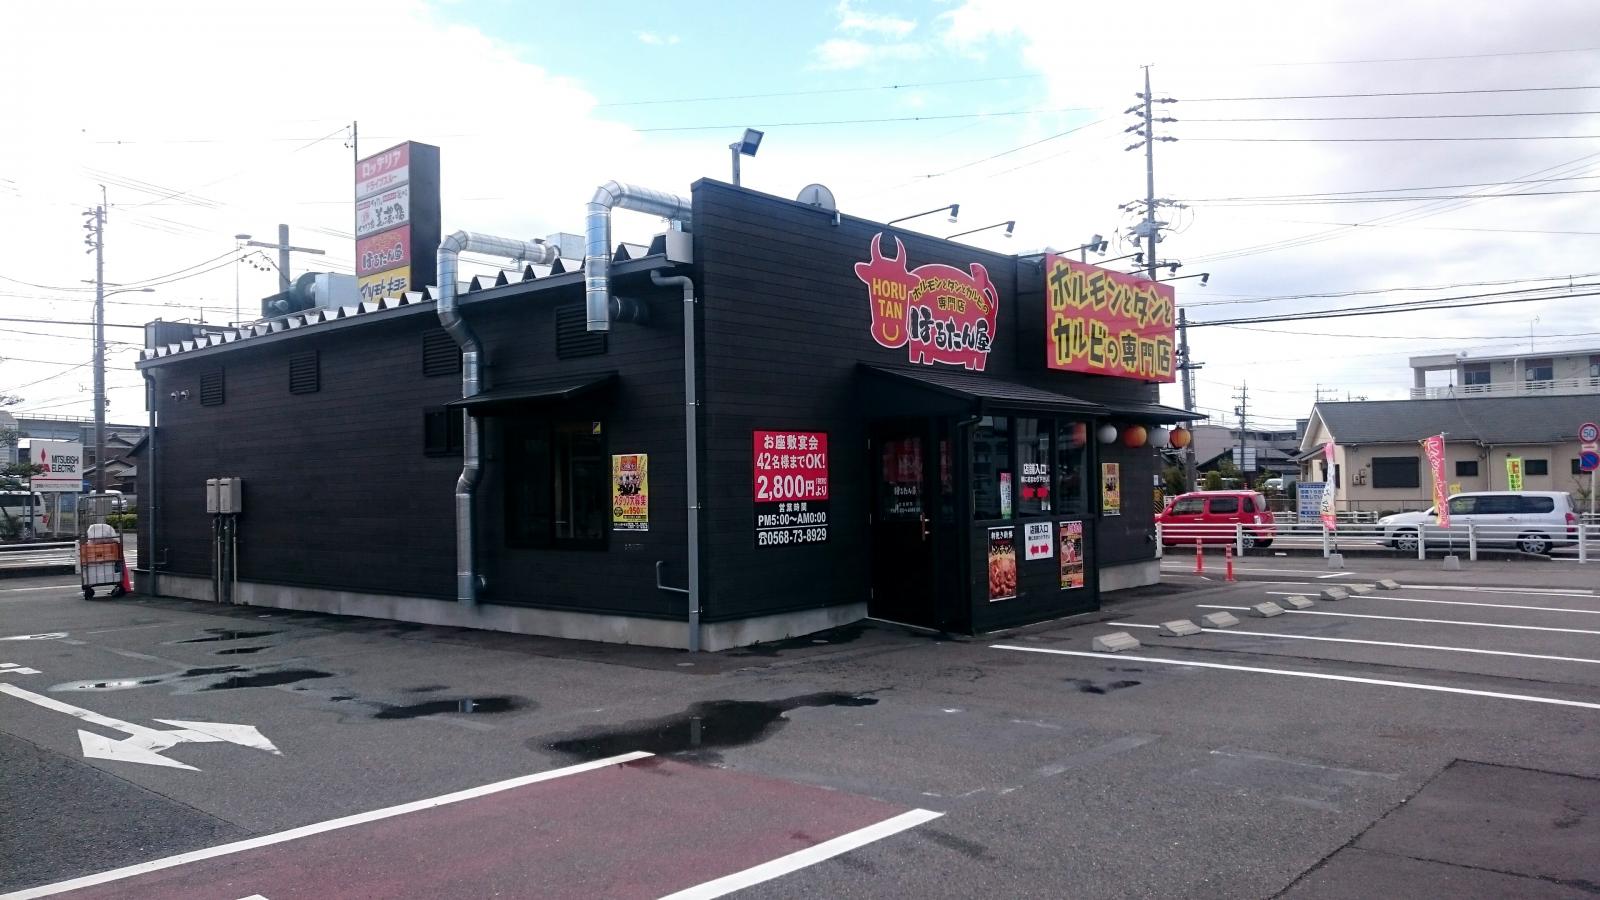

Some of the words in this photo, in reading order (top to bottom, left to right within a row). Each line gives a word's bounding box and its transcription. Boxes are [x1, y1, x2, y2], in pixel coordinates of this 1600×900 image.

[362, 150, 401, 178] ロッテリア
[872, 277, 907, 300] HORU
[1049, 261, 1172, 329] ホルモンとタンと
[878, 299, 903, 320] TAN
[937, 294, 967, 314] 専門店
[908, 305, 992, 353] ほるたん屋
[1051, 313, 1172, 377] カルビの専門店
[764, 434, 819, 450] お座敷宴会
[1583, 429, 1595, 438] 50
[51, 464, 76, 473] ELECTRIC
[52, 455, 80, 465] MITSUBISHI
[778, 502, 808, 513] 営業時間
